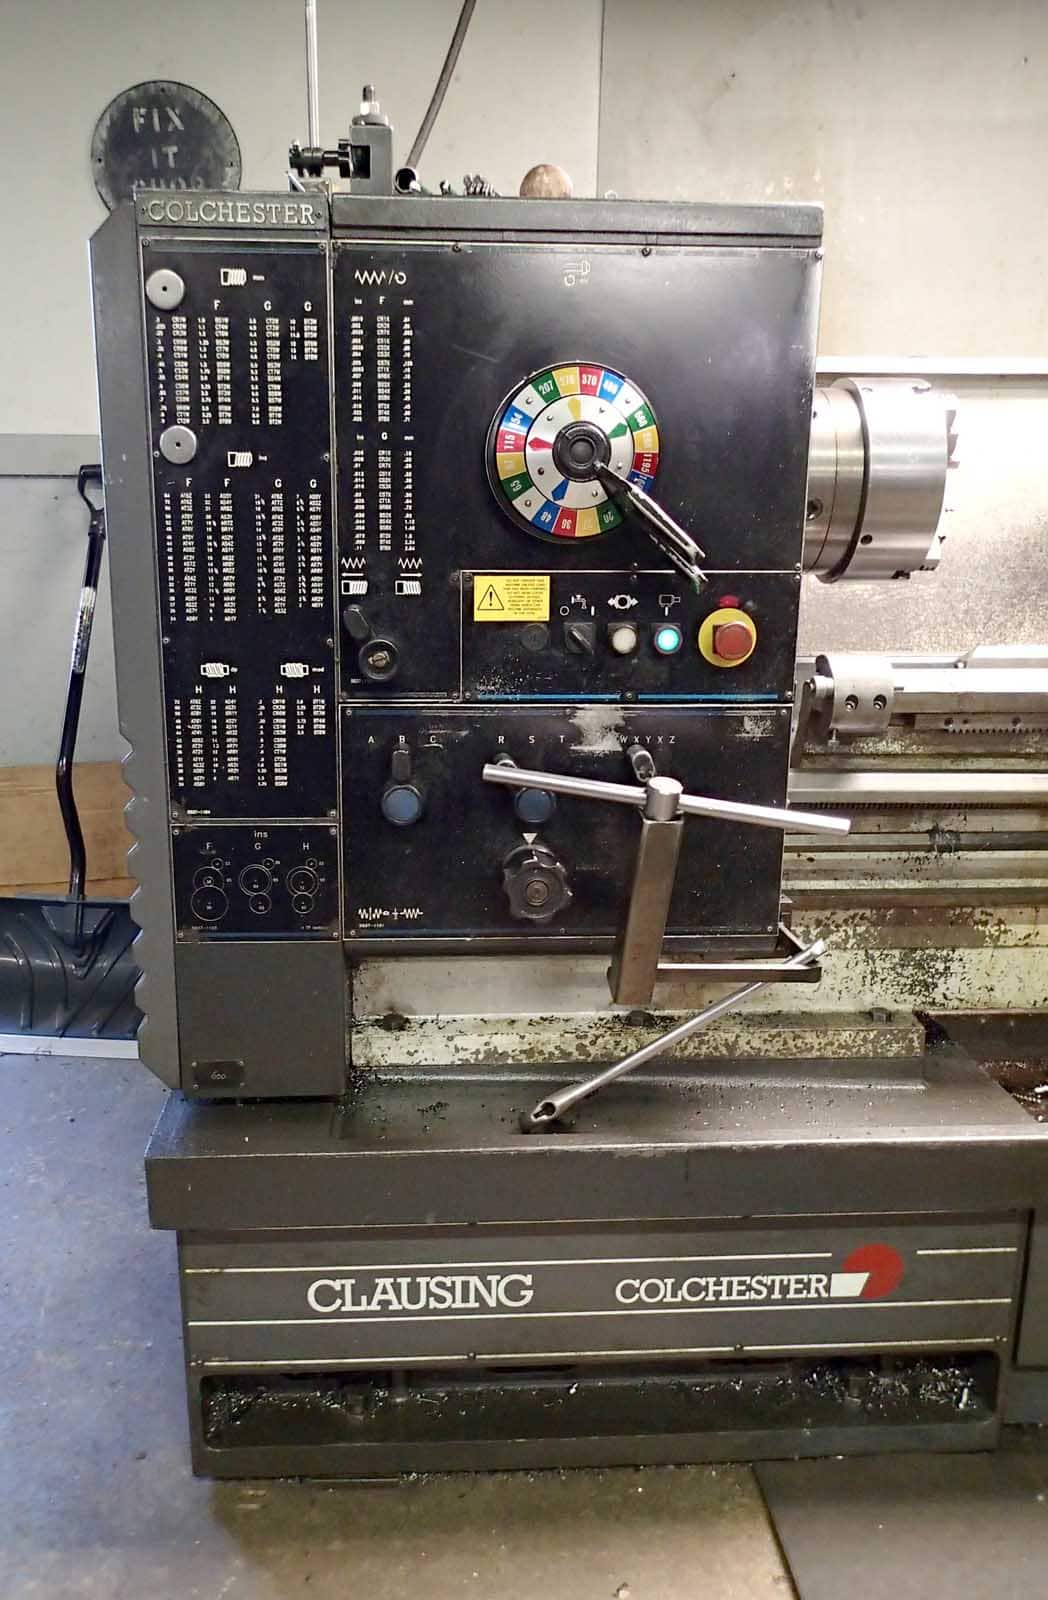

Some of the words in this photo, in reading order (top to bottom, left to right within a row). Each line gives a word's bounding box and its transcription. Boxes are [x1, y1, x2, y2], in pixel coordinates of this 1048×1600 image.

[132, 107, 184, 133] FIX
[151, 146, 178, 169] IT
[149, 201, 315, 225] COLCHESTER
[214, 300, 221, 311] F
[379, 296, 386, 304] F
[264, 301, 271, 311] G
[304, 301, 312, 311] G
[581, 374, 596, 386] 370
[539, 380, 553, 394] 207
[381, 432, 388, 441] G
[503, 433, 515, 450] 115
[641, 453, 652, 473] 1195
[186, 477, 193, 488] F
[224, 478, 231, 488] F
[275, 479, 282, 488] G
[309, 479, 317, 489] G
[510, 479, 522, 492] 65
[540, 511, 552, 522] 48
[195, 685, 202, 694] H
[229, 685, 236, 694] H
[276, 685, 283, 694] H
[313, 685, 320, 694] H
[368, 735, 375, 744] A
[399, 735, 406, 744] B
[430, 735, 437, 743] C
[498, 735, 505, 744] R
[528, 735, 535, 744] S
[560, 735, 566, 744] T
[254, 830, 268, 838] ins
[206, 842, 213, 850] F
[254, 842, 262, 850] G
[302, 842, 310, 850] H
[307, 1274, 534, 1313] CLAUSING
[615, 1273, 829, 1304] COLCHESTER
